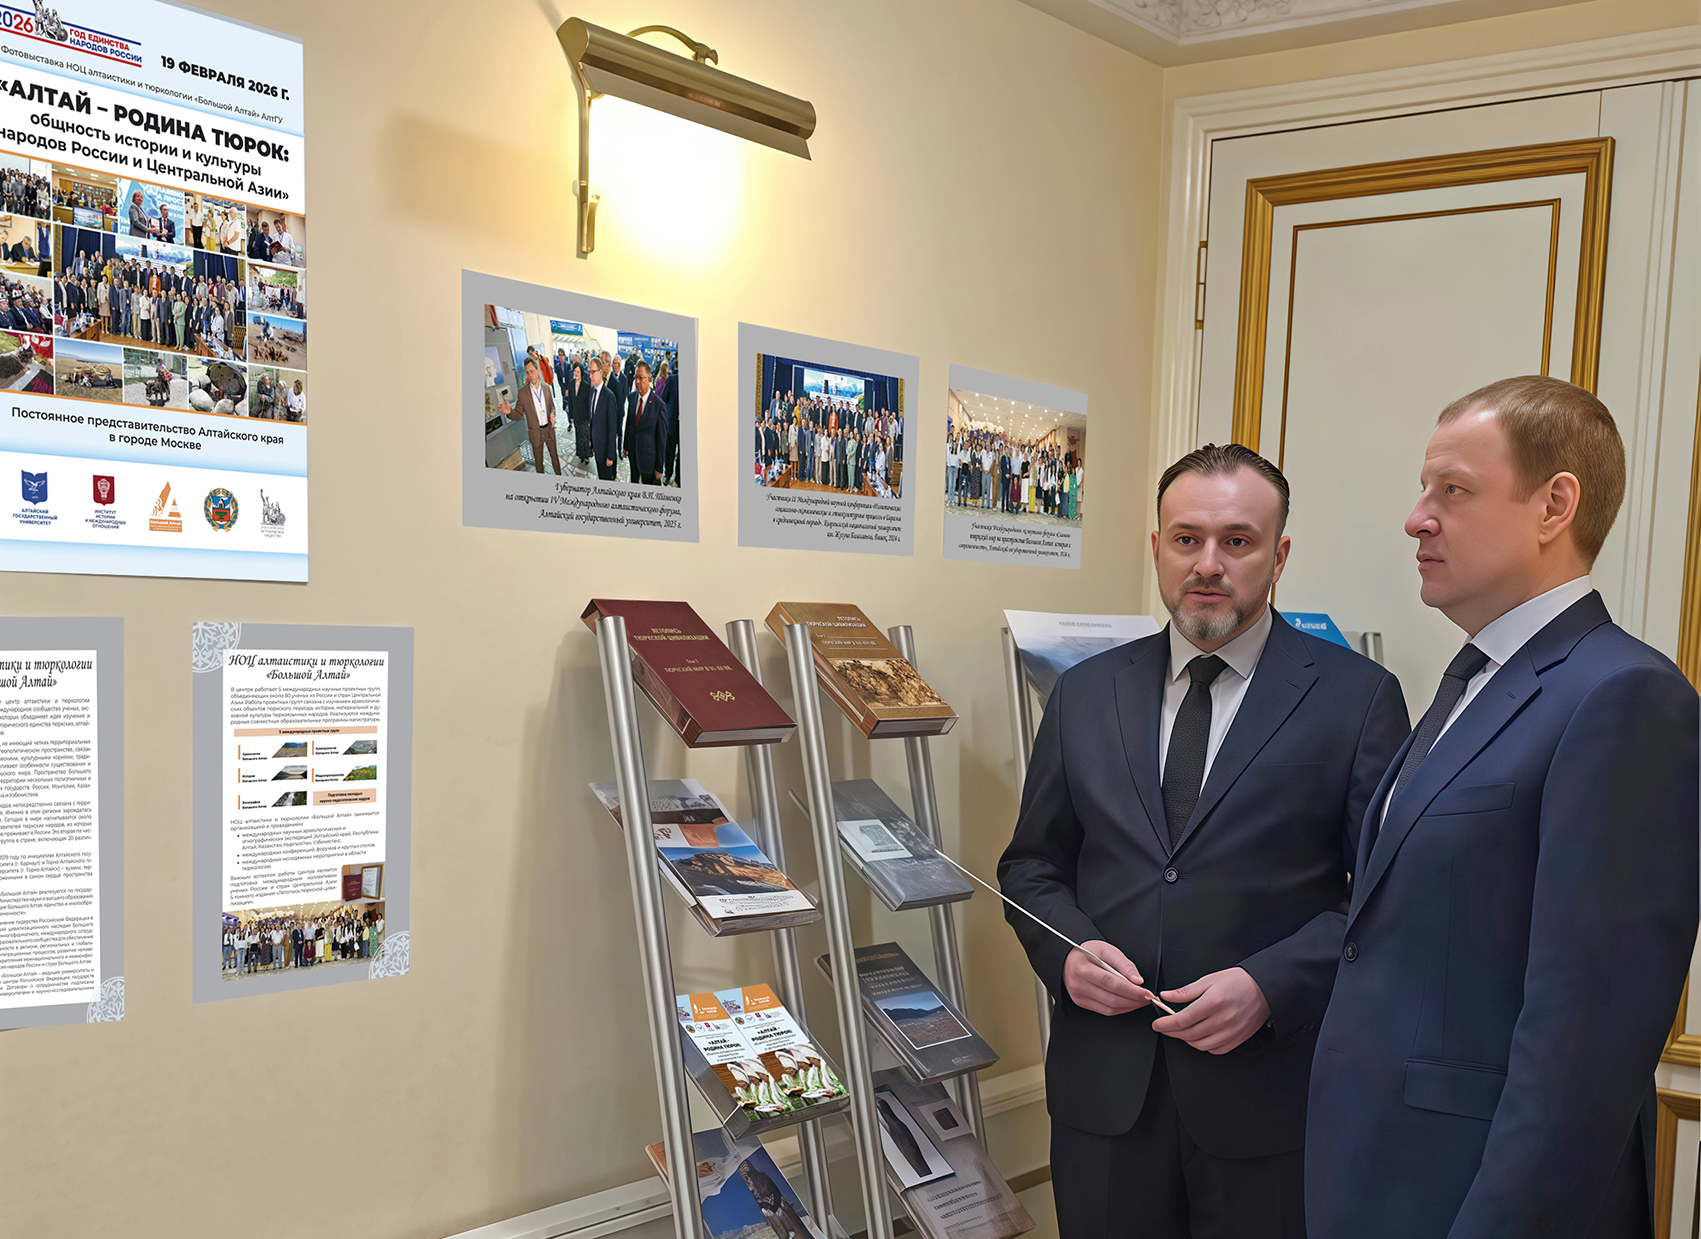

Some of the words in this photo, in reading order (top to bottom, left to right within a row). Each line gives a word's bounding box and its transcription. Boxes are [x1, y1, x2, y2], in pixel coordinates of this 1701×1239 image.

[0, 10, 33, 33] 026
[69, 28, 86, 41] ГОД
[87, 33, 130, 51] ЕДИНСТВА
[69, 37, 108, 54] НАРОДОВ
[109, 48, 142, 63] РОССИИ
[0, 45, 64, 68] Фотовыставка
[66, 61, 87, 75] НОЦ
[87, 68, 136, 87] алтаистики
[144, 83, 193, 101] тюркологии
[194, 95, 233, 111] «Большой
[233, 105, 260, 118] Алтай»
[261, 112, 283, 124] АлтГУ
[160, 55, 175, 69] 19
[178, 61, 245, 89] ФЕВРАЛЯ
[248, 79, 278, 98] 2026
[281, 88, 290, 101] Г.
[30, 113, 111, 141] общность
[114, 133, 178, 157] истории
[182, 148, 191, 160] и
[195, 152, 261, 176] культуры
[114, 105, 206, 143] РОДИНА
[211, 128, 289, 162] ТЮРОК:
[0, 128, 67, 152] народов
[71, 142, 128, 166] России
[133, 157, 142, 169] и
[146, 157, 244, 191] Центральной
[247, 181, 289, 200] Азии»
[11, 407, 84, 424] Постоянное
[87, 416, 196, 436] представительство
[198, 426, 258, 442] Алтайского
[260, 435, 284, 445] края
[109, 433, 116, 442] в
[118, 434, 158, 447] городе
[161, 437, 202, 450] Москве
[25, 661, 31, 670] и
[33, 660, 92, 674] тюркологии
[228, 655, 256, 668] НОЦ
[258, 657, 318, 669] алтаистики
[320, 658, 326, 666] и
[328, 658, 384, 669] тюркологии
[18, 675, 57, 690] Алтай»
[266, 669, 312, 680] «Большой
[313, 668, 351, 681] Алтай»
